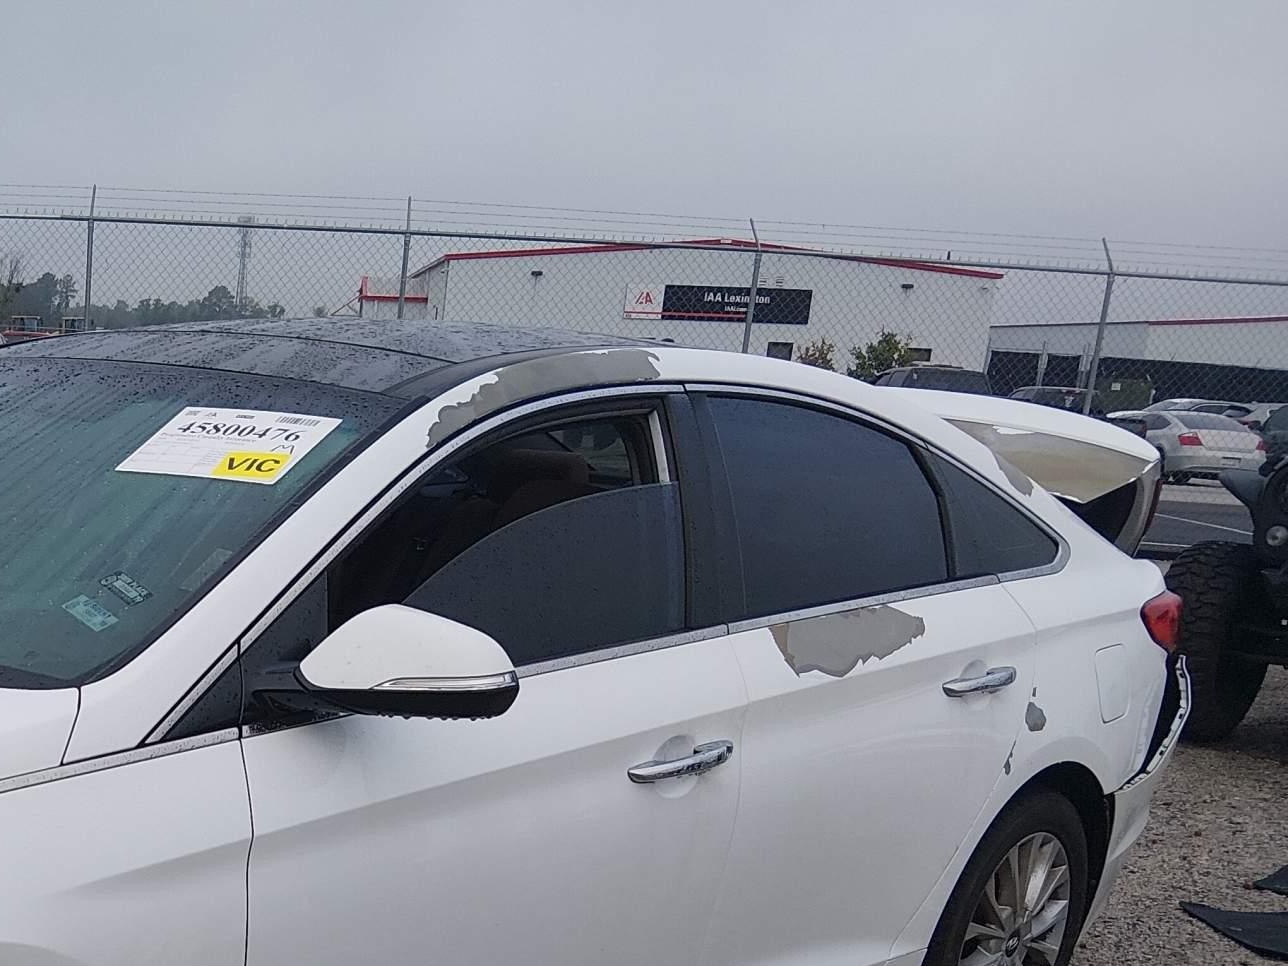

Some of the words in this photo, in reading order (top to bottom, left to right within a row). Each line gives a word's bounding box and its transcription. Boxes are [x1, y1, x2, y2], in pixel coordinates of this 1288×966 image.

[704, 292, 722, 302] IAA
[724, 292, 771, 304] Lexinton
[177, 421, 306, 442] 45800476
[227, 457, 281, 473] VIC
